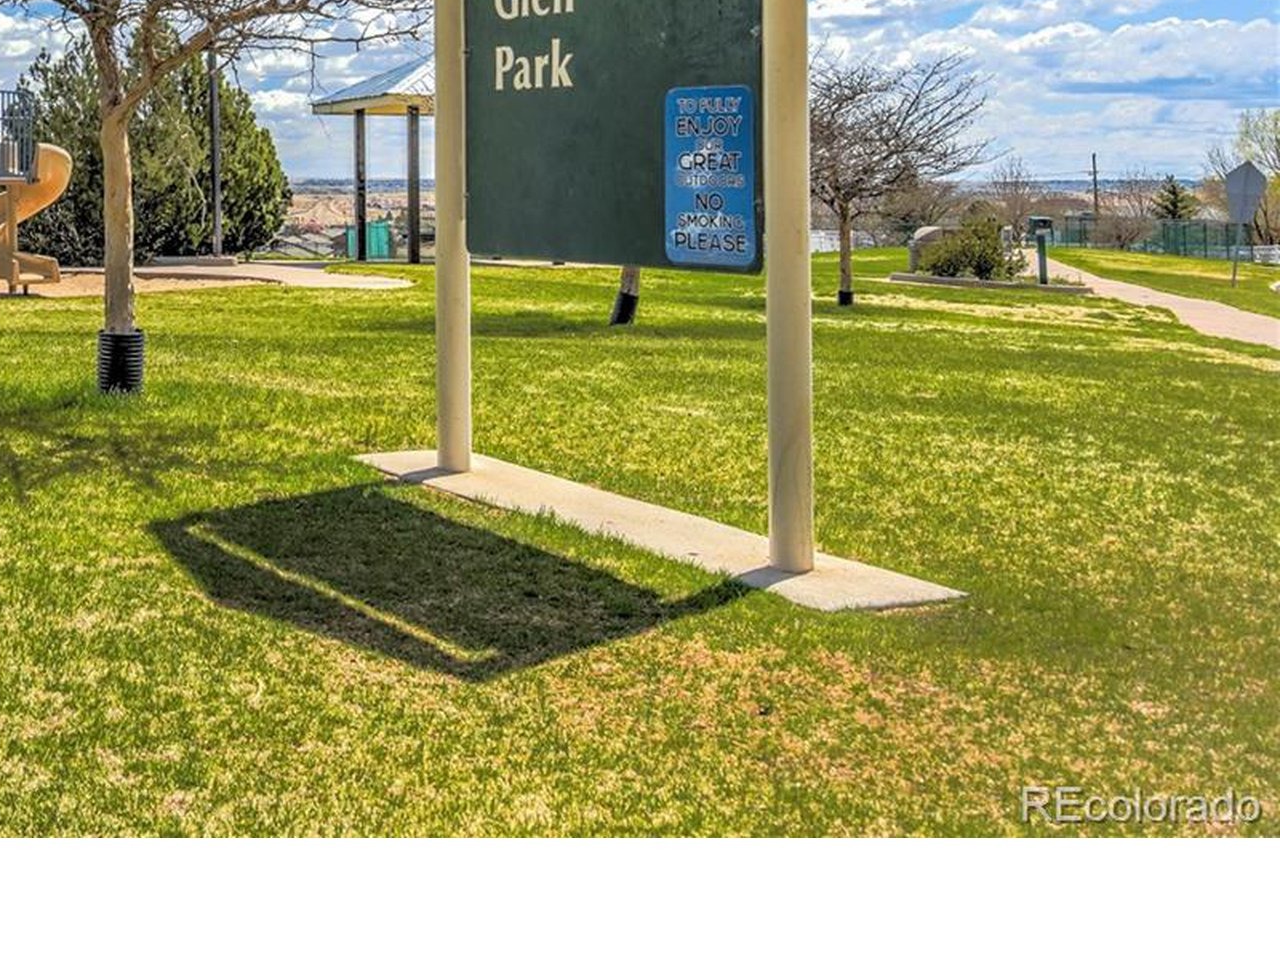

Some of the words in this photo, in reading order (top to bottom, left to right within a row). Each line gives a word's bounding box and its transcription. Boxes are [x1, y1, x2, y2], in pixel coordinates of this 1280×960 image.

[495, 38, 573, 90] Park
[677, 98, 697, 114] TO
[675, 115, 743, 137] ENJOY
[678, 152, 742, 172] GREAT
[694, 192, 724, 211] NO
[678, 213, 745, 230] SMOKING
[674, 231, 746, 254] PLEASE
